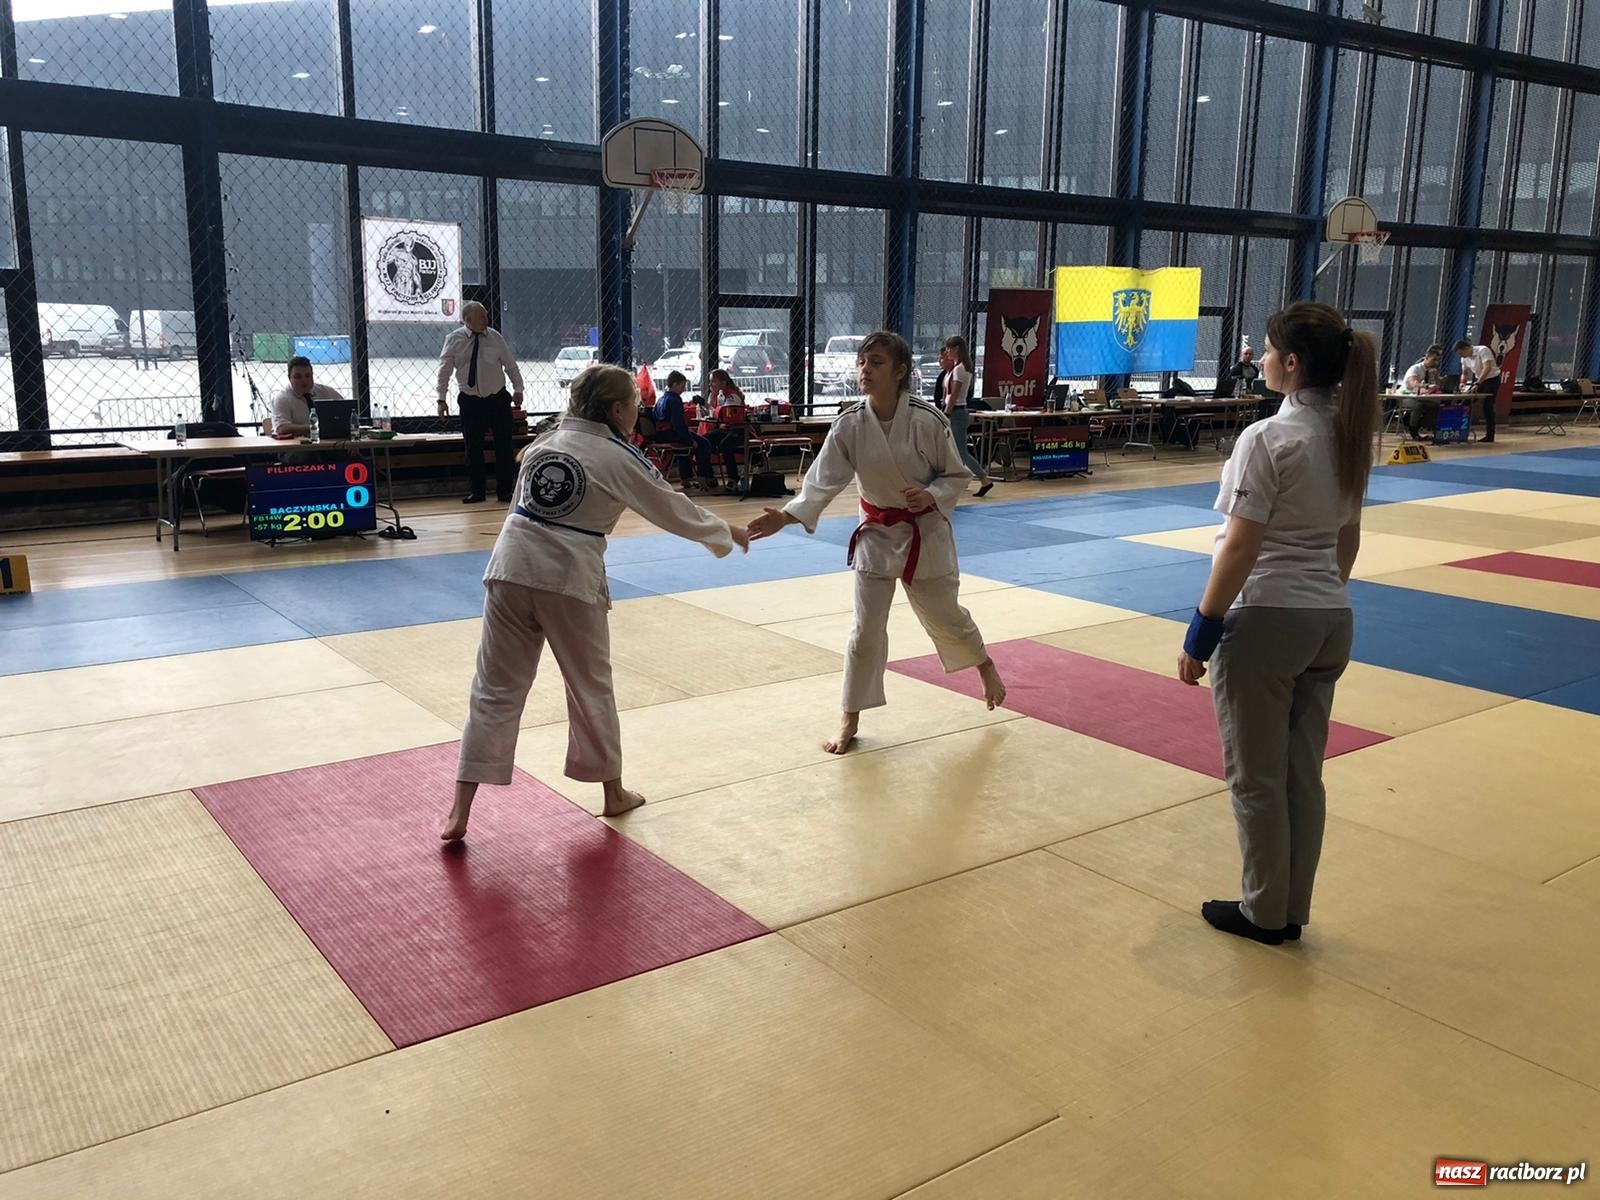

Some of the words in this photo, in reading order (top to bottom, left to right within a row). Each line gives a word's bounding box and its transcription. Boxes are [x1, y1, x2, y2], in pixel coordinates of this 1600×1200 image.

[999, 380, 1036, 399] wolf
[1393, 449, 1400, 460] 3
[267, 465, 325, 474] FILIPCZAK
[328, 463, 336, 471] N
[344, 462, 368, 485] 0
[346, 485, 370, 508] 0
[270, 504, 337, 514] BACZYNSKA
[270, 523, 282, 531] kg
[283, 511, 344, 531] 2:00
